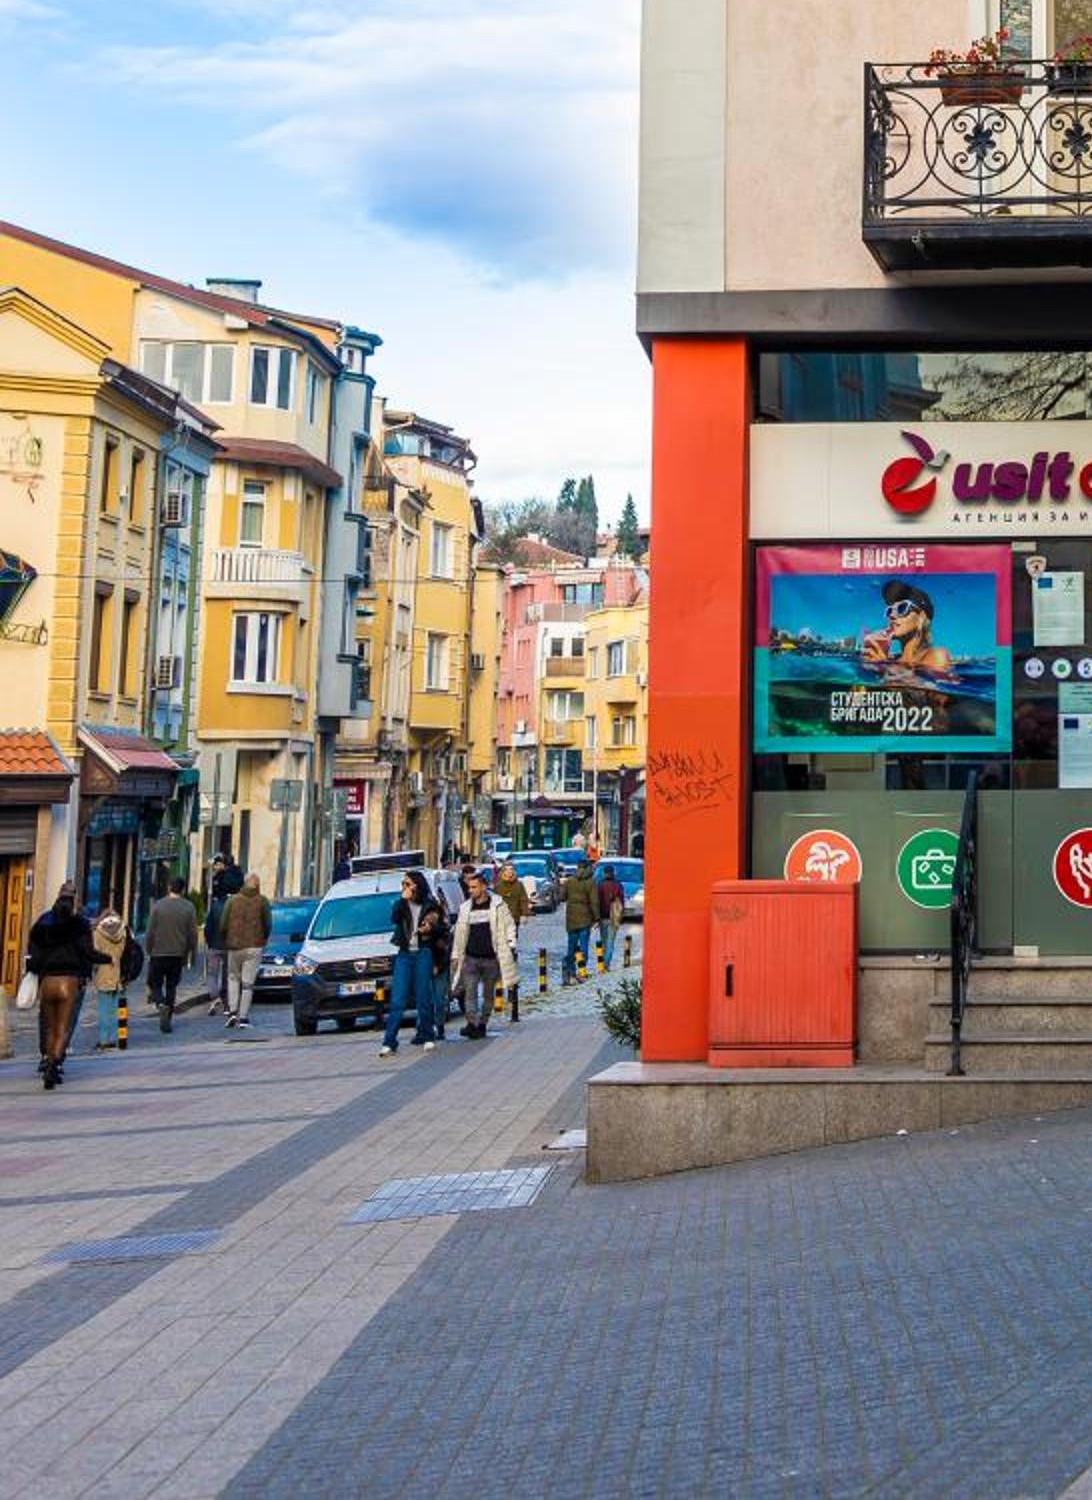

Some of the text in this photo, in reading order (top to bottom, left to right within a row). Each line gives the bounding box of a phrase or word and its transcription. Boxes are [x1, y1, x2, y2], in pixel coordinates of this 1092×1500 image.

[952, 452, 1074, 503] usit
[952, 511, 1041, 523] АГЕНЦИЯ
[1050, 511, 1070, 522] ЗА
[875, 547, 909, 569] USA
[831, 691, 903, 707] СТУДЕНТСКА
[831, 706, 933, 731] БРИГАДА 2022
